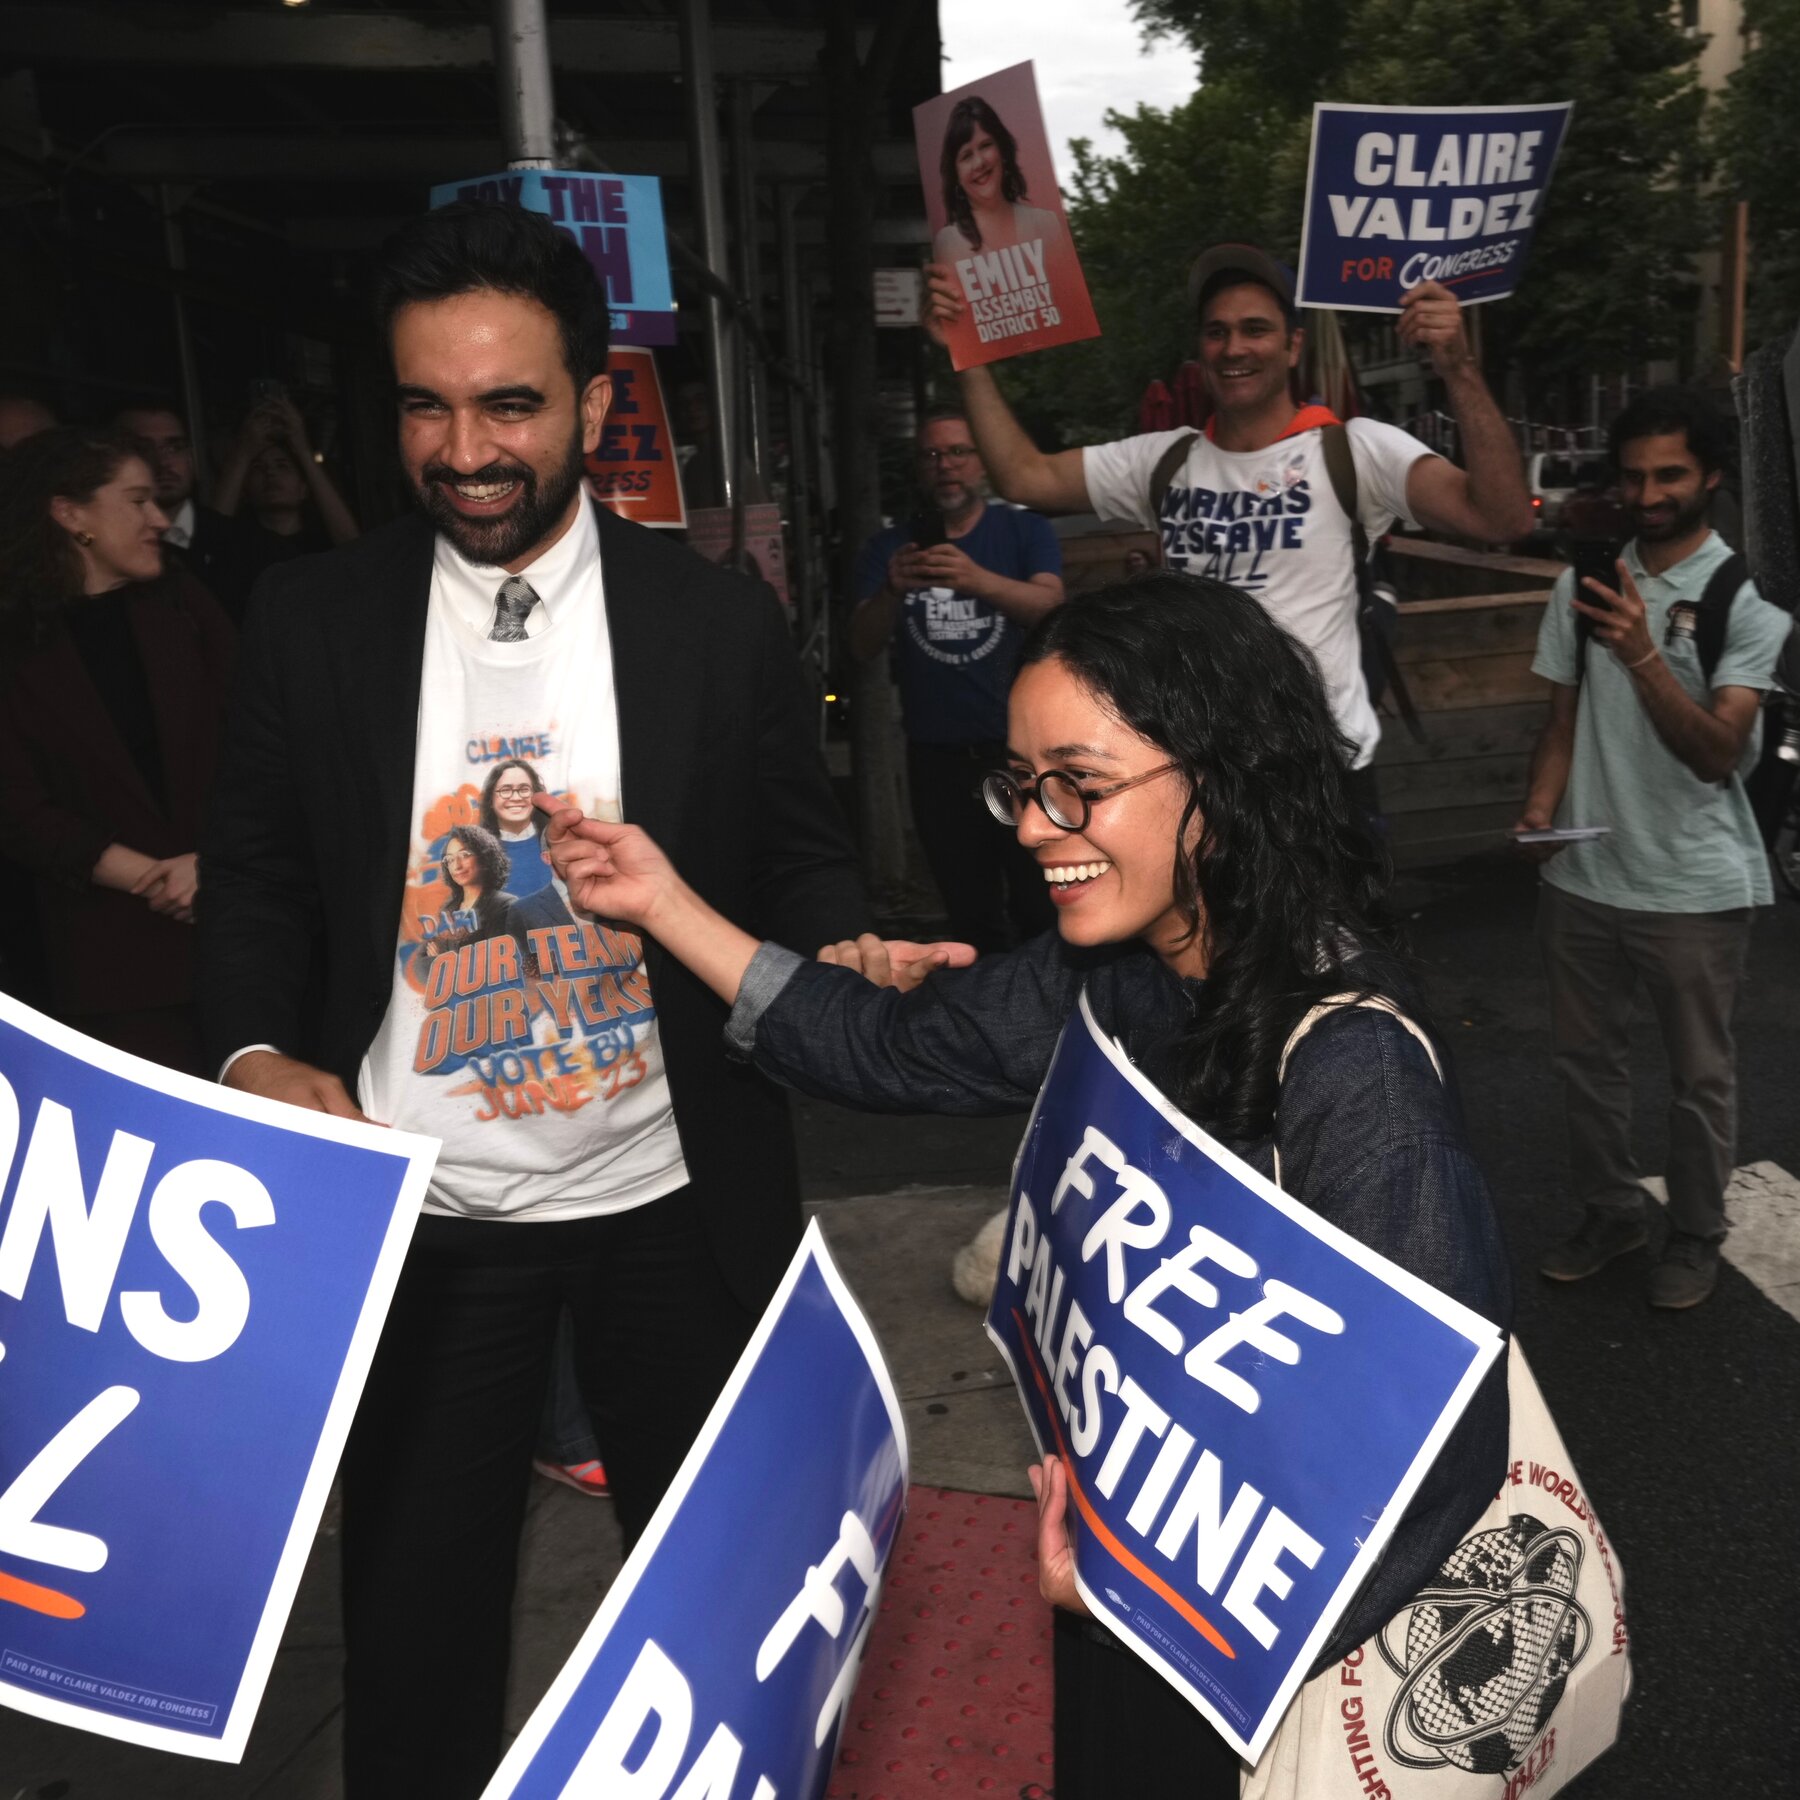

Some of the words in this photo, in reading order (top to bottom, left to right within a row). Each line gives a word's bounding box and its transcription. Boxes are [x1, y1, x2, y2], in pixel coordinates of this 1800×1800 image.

[1354, 130, 1544, 187] CLAIRE
[541, 176, 628, 224] THE
[1328, 189, 1542, 241] VALDEZ
[955, 238, 1048, 303] EMILY
[1341, 256, 1394, 282] FOR
[1399, 239, 1520, 290] CONGRESS
[970, 282, 1053, 325] ASSEMBLY
[976, 312, 1038, 344] DISTRICT
[1040, 306, 1062, 328] 50
[926, 598, 977, 621] EMILY
[424, 934, 524, 1010] OUR
[526, 924, 643, 977] TEAM
[412, 987, 534, 1076] OUR
[468, 1040, 582, 1088] VOTE
[474, 1074, 594, 1122] JUNE
[600, 1052, 648, 1100] 23
[0, 1072, 276, 1363] NS
[1051, 1125, 1345, 1414] FREE
[1007, 1193, 1325, 1650] PALESTINE
[6, 1657, 28, 1672] PAID
[29, 1665, 47, 1679] FOR
[49, 1671, 62, 1684] BY
[63, 1676, 98, 1694] CLAIRE
[99, 1685, 136, 1704] VALDEZ
[137, 1695, 158, 1709] FOR
[159, 1700, 209, 1719] CONGRESS
[1136, 1615, 1151, 1630] PAID
[1150, 1625, 1162, 1637] FOR
[1162, 1636, 1171, 1647] BY
[1169, 1644, 1189, 1665] CLAIRE
[1189, 1661, 1211, 1685] VALDEZ
[1209, 1682, 1221, 1696] FOR
[1220, 1693, 1246, 1724] CONGRESS
[1341, 1643, 1365, 1687] FO
